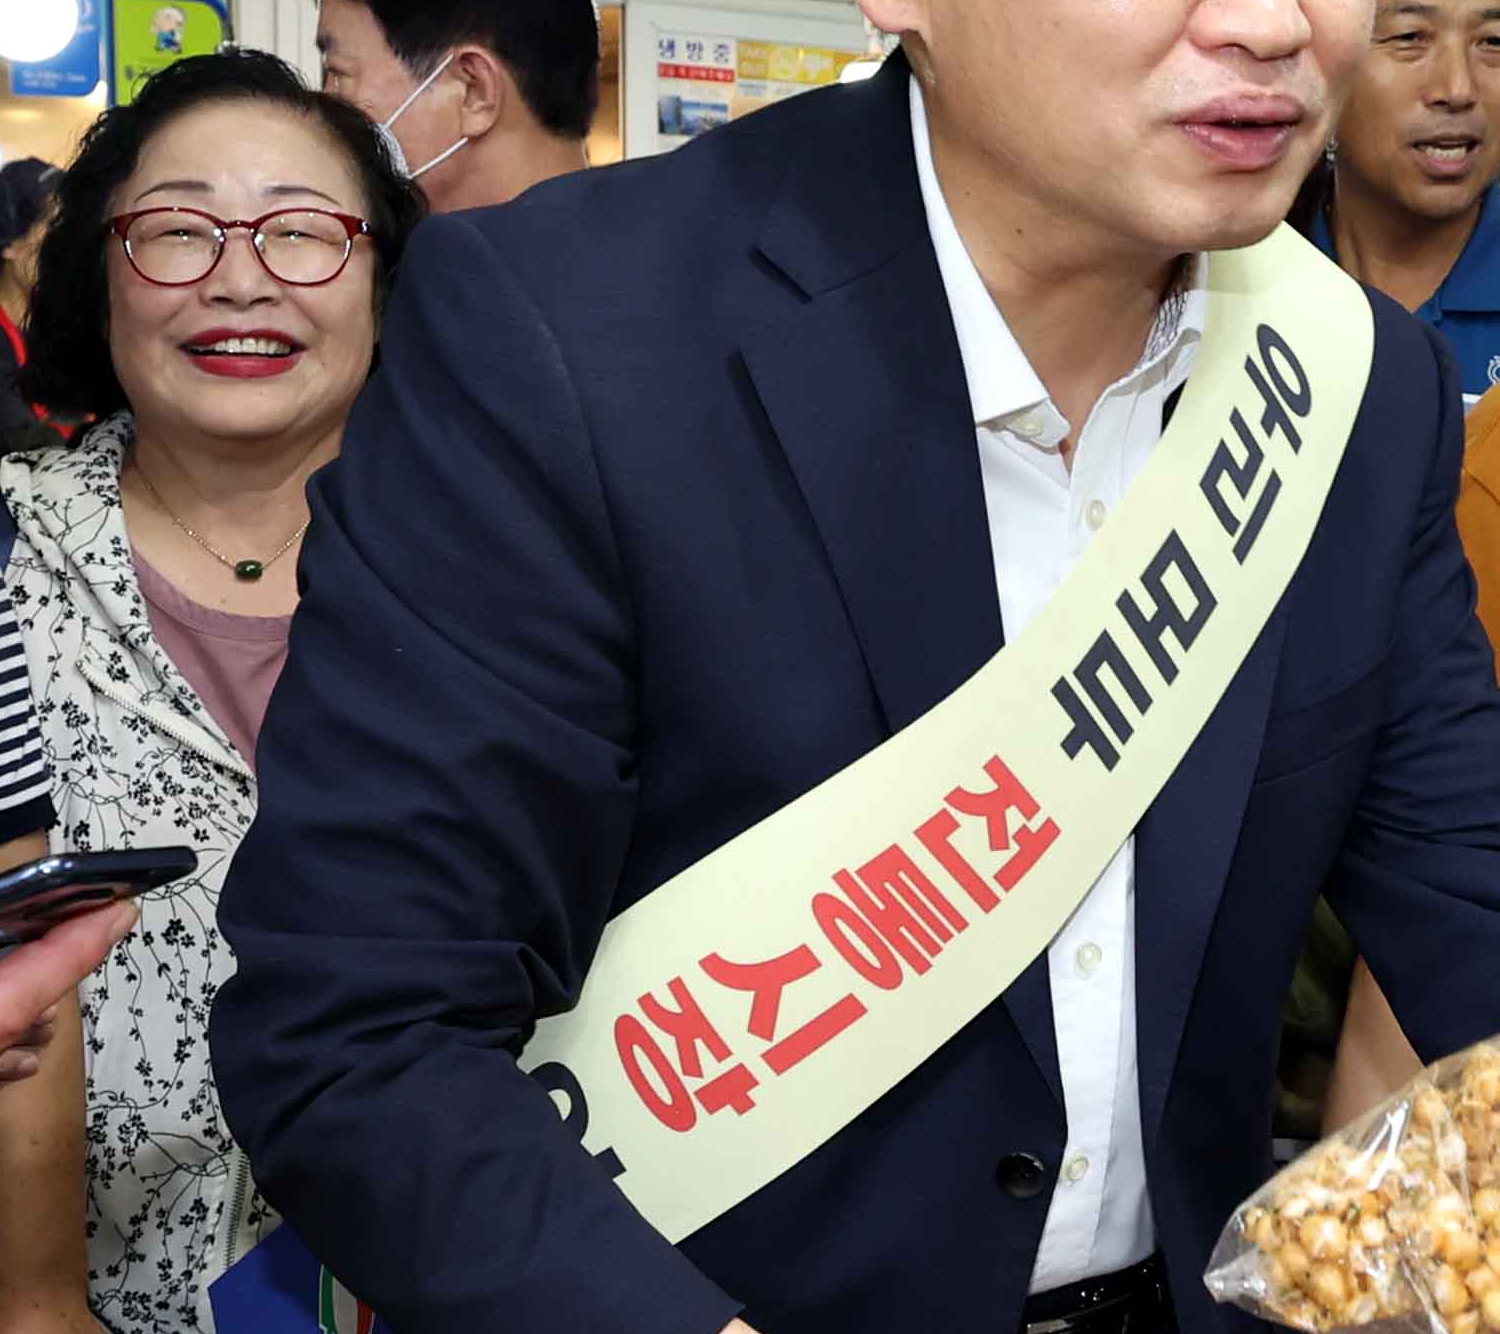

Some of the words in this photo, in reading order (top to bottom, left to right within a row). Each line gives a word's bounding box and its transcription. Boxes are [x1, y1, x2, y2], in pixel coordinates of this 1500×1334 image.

[1201, 322, 1314, 565] 우리
[1051, 528, 1218, 771] 모두
[614, 753, 1063, 1132] 전통시장
